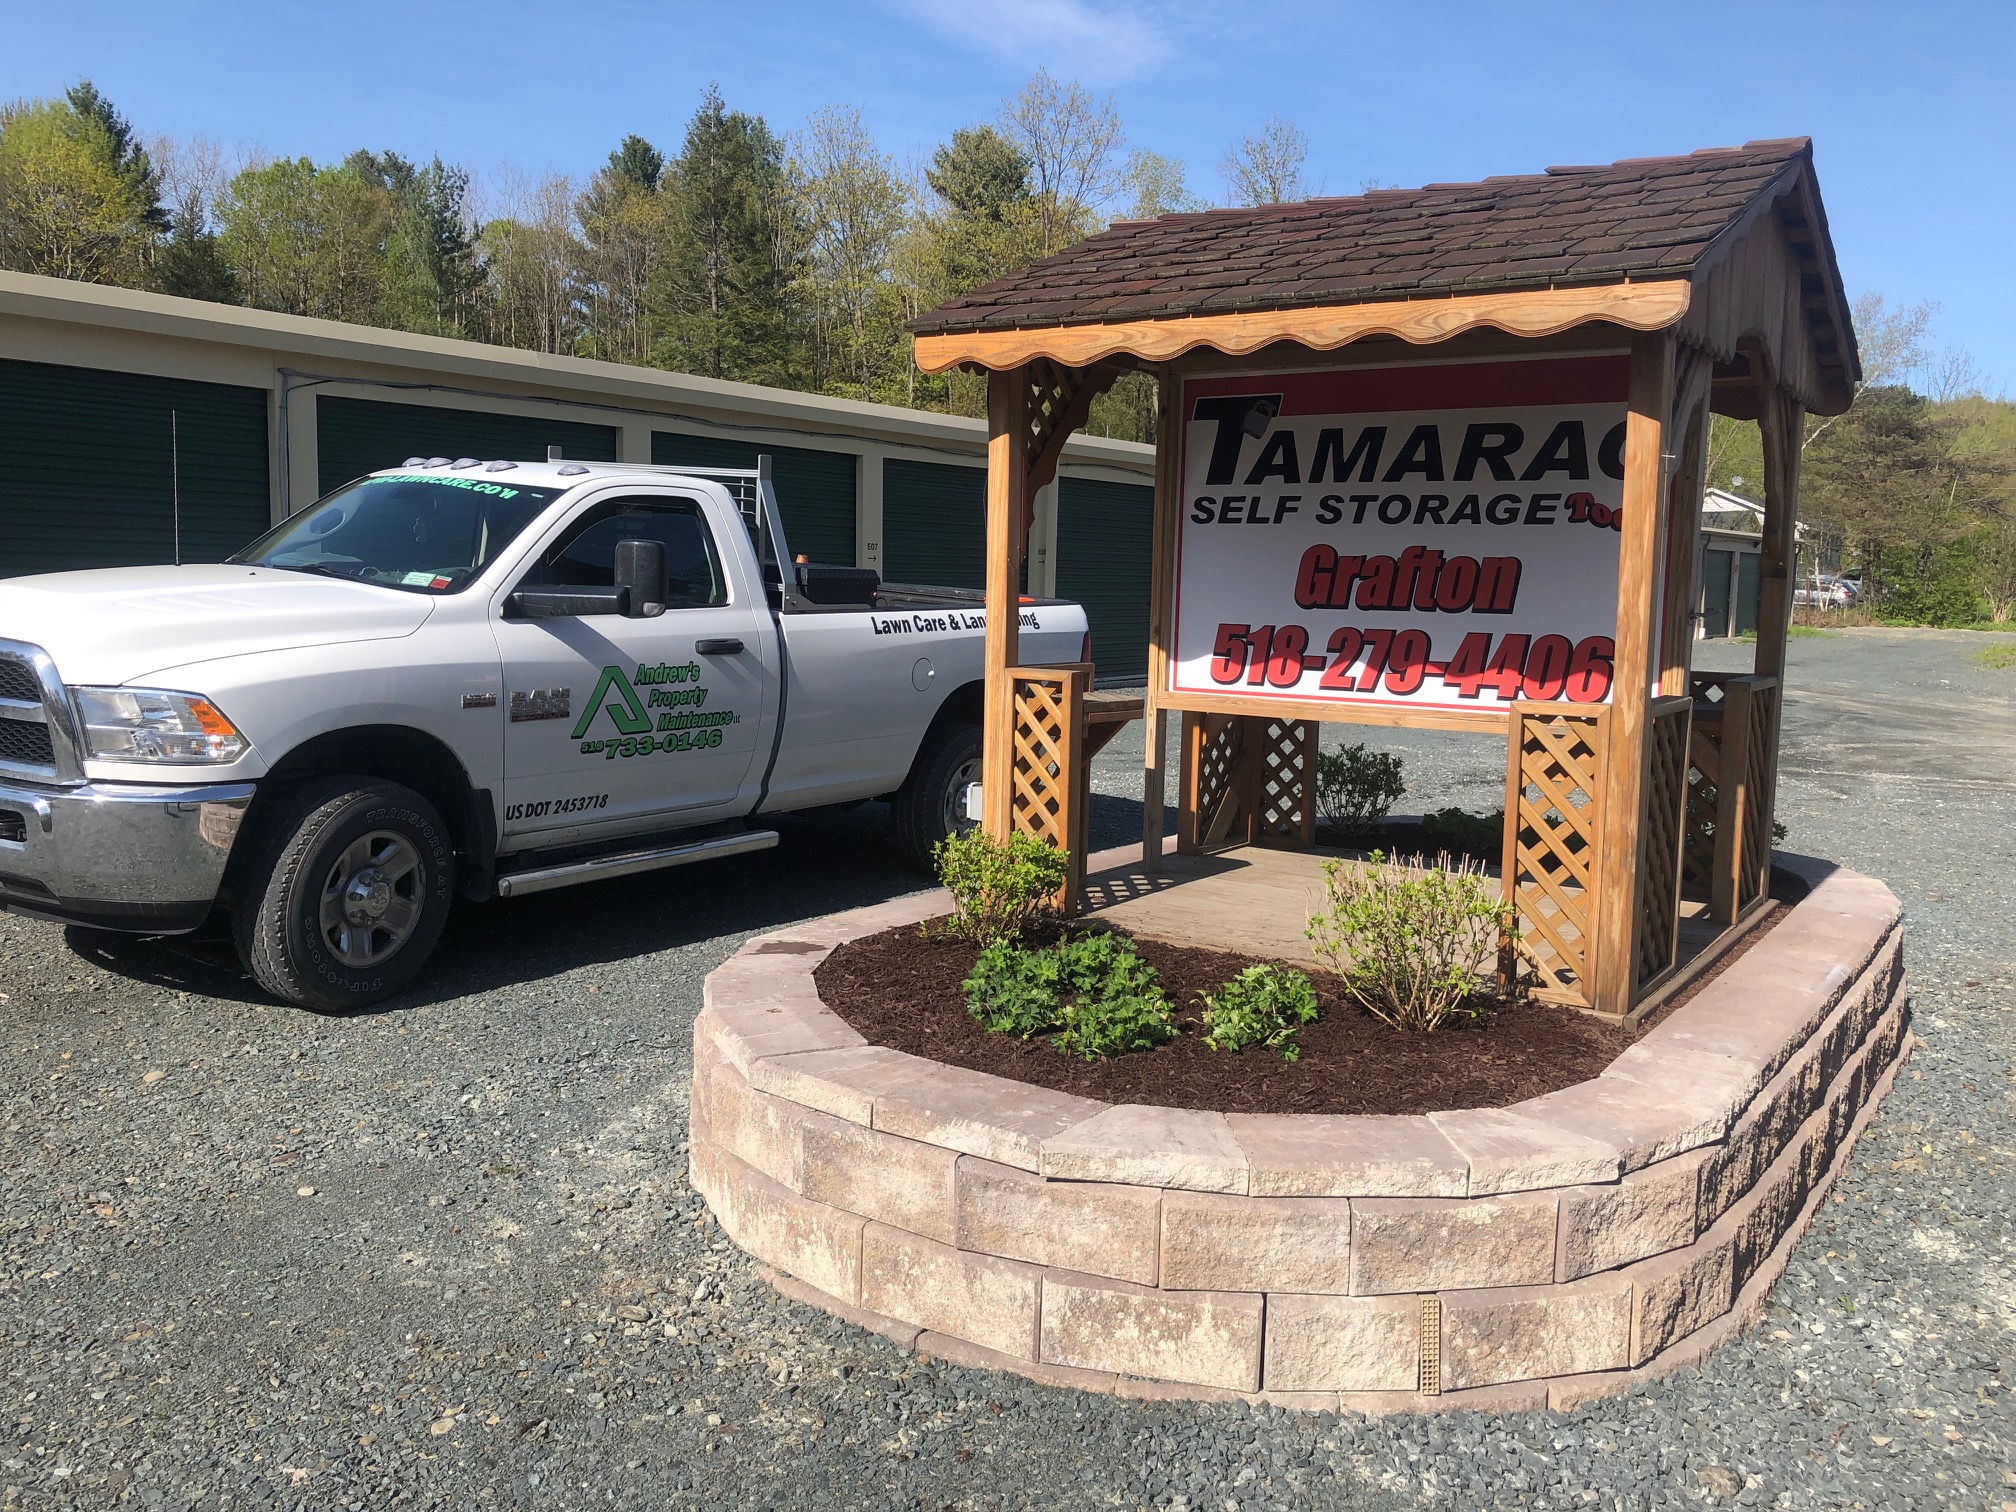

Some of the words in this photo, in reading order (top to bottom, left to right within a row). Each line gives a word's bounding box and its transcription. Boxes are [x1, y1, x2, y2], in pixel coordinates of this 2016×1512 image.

[1190, 495, 1302, 526] SELF
[1315, 493, 1563, 526] STORAGE
[867, 542, 878, 551] E07
[1294, 543, 1523, 615] Grafton
[870, 616, 913, 635] Lawn
[913, 614, 947, 633] Care
[947, 613, 962, 631] &
[960, 611, 1041, 630] Laning
[633, 660, 700, 686] Andrew's
[1210, 623, 1616, 704] 518-279-4406
[647, 686, 708, 709] Property
[656, 710, 733, 732] Maintenance
[580, 740, 605, 755] 518
[605, 728, 723, 761] 733-0146
[505, 802, 524, 821] US
[524, 800, 553, 819] DOT
[552, 793, 609, 815] 2453718
